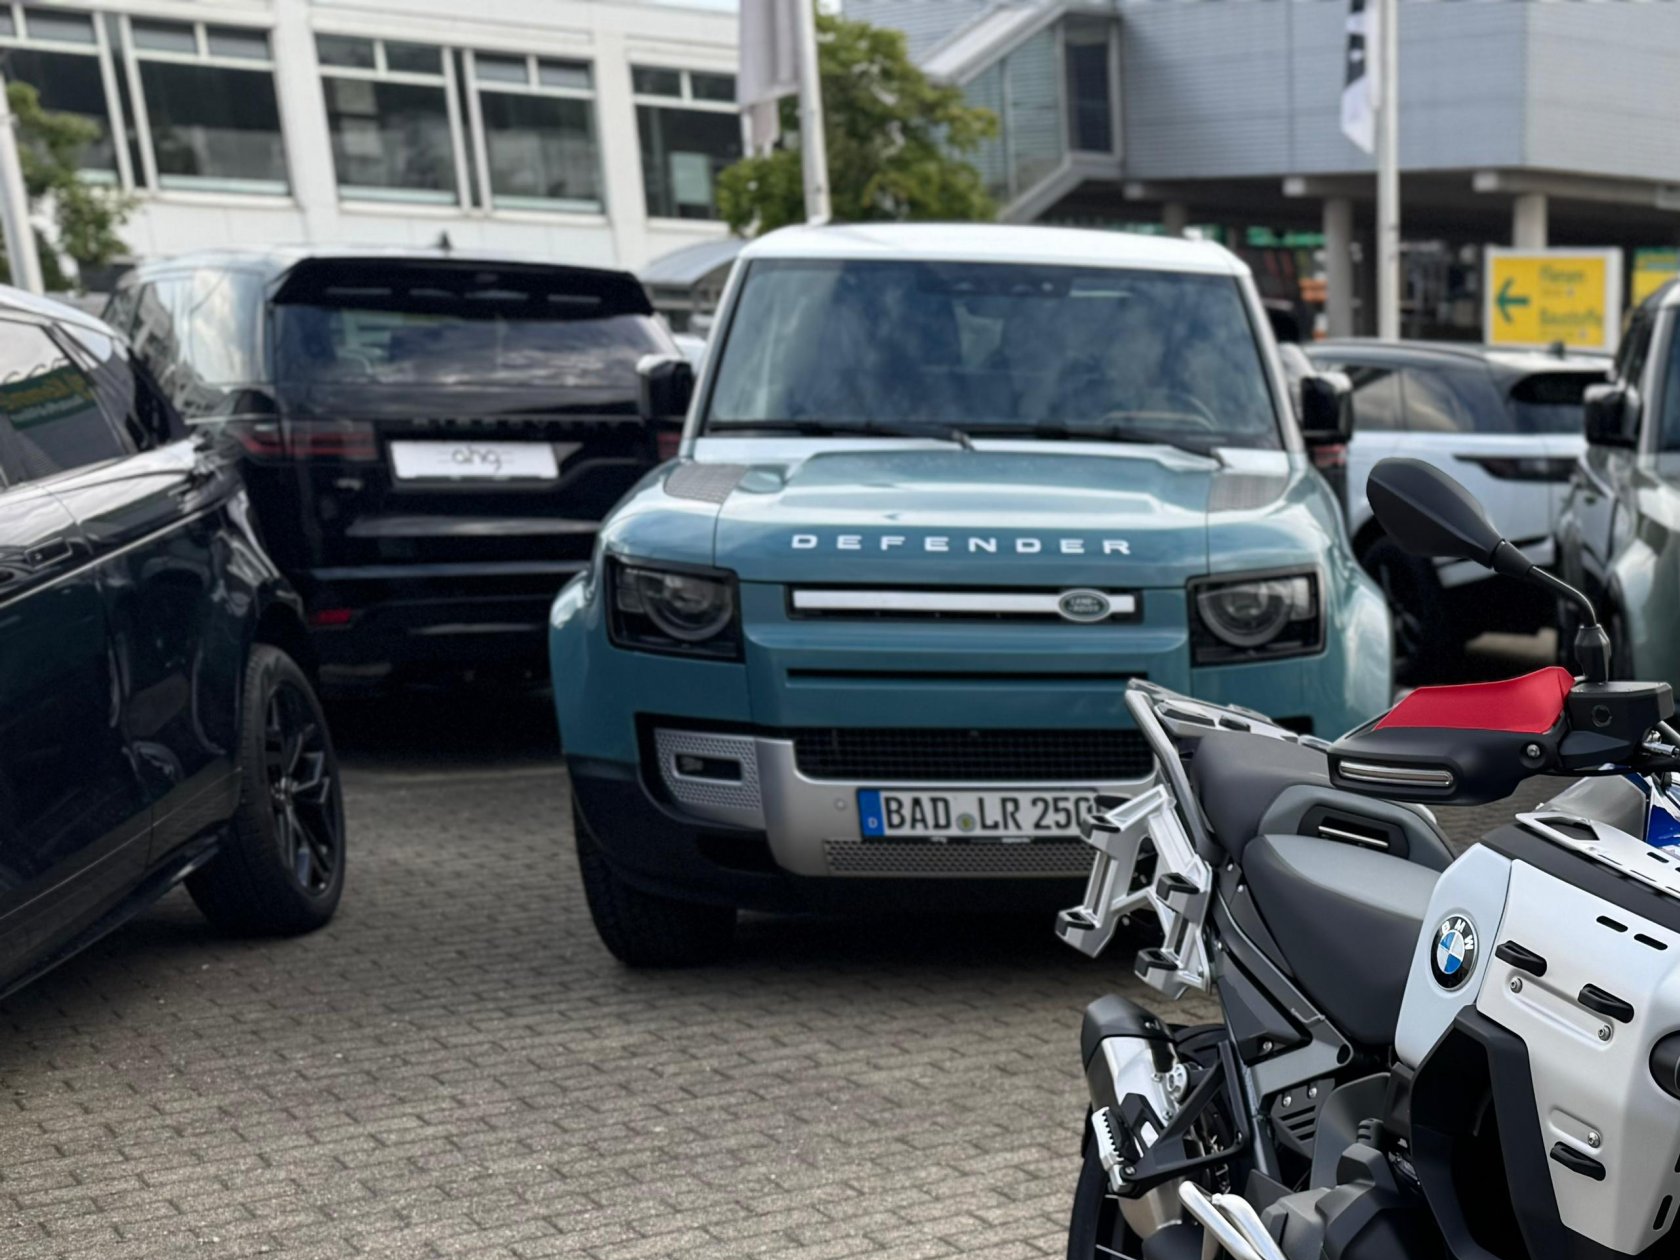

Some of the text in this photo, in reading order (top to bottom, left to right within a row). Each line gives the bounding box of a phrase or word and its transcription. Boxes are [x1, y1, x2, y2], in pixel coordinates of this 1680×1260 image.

[791, 534, 1131, 555] DEFENDER
[884, 796, 952, 830] BAD
[978, 796, 1022, 830] LR
[1441, 918, 1474, 950] BMW
